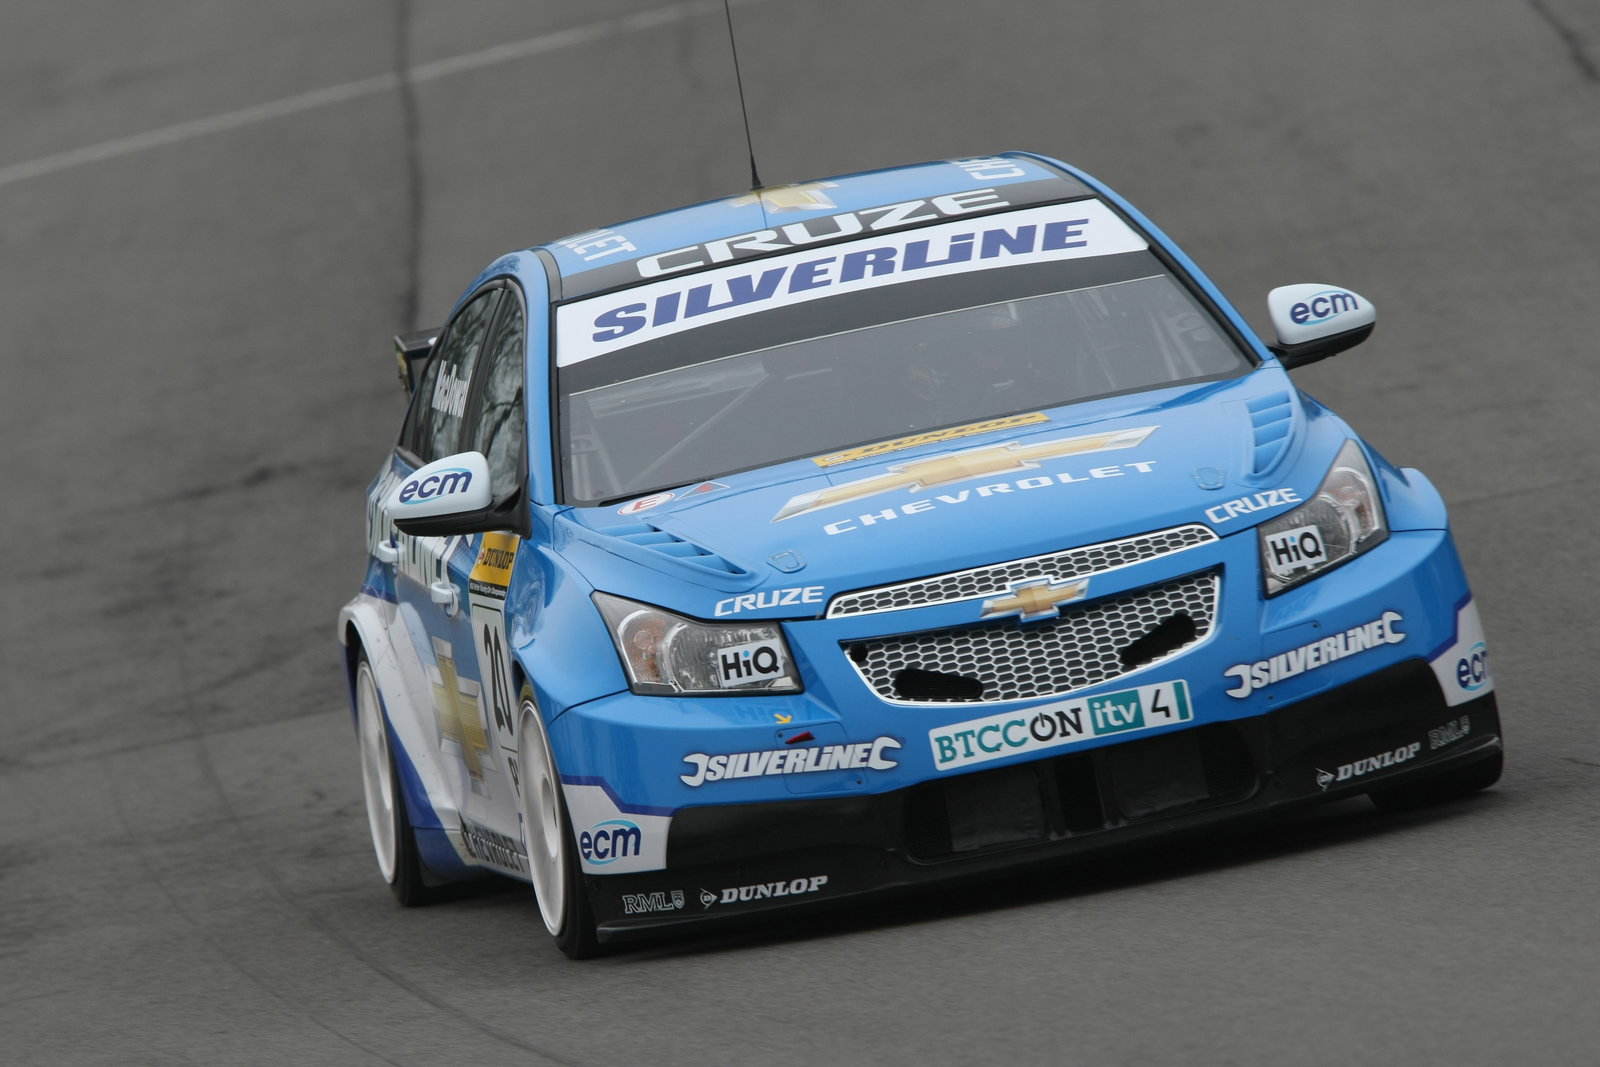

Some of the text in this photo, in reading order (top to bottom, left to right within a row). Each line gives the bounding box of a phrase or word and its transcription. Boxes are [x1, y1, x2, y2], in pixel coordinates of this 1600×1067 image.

[636, 188, 1010, 277] CRUZE
[592, 218, 1089, 342] SILVERLiNE
[1290, 293, 1358, 324] ecm
[859, 415, 1038, 453] DUNLOP
[399, 471, 473, 503] ecm
[823, 460, 1158, 535] CHEVROLET
[1205, 488, 1303, 523] CRUZE
[483, 548, 514, 570] DUNLOP
[1271, 532, 1322, 566] HiQ
[715, 586, 825, 617] CRUZE
[721, 646, 779, 681] HiQ
[1250, 620, 1386, 688] SILVERLiNE
[484, 623, 513, 735] 20
[1093, 700, 1137, 728] itv
[703, 741, 874, 781] SILVERLiNE
[1336, 742, 1420, 781] DUNLOP
[580, 827, 642, 860] ecm
[622, 892, 674, 914] RML
[720, 875, 828, 903] DUNLOP
